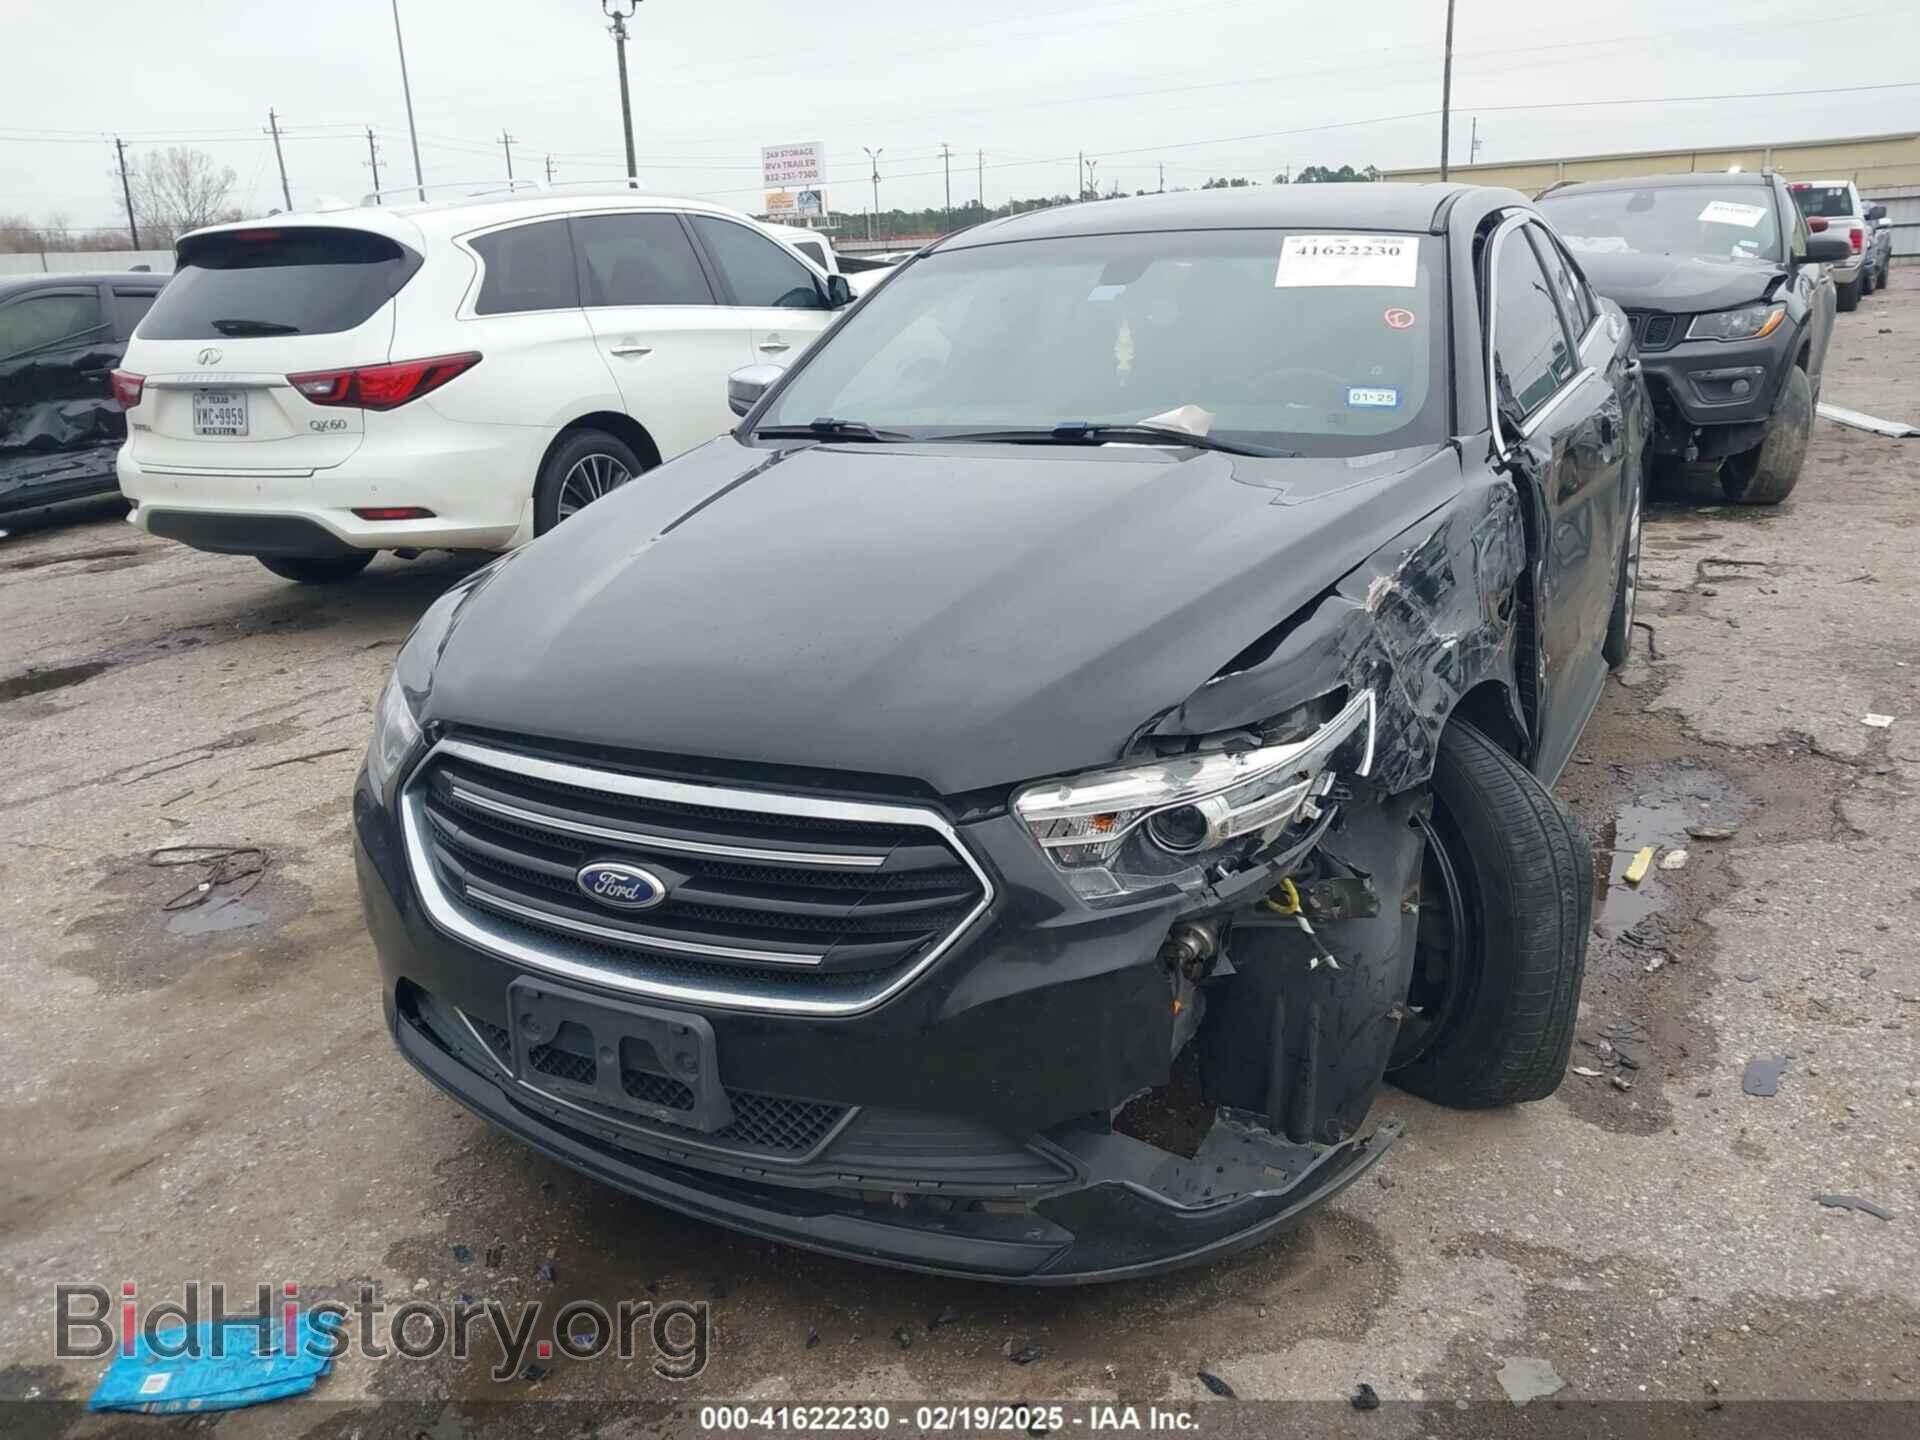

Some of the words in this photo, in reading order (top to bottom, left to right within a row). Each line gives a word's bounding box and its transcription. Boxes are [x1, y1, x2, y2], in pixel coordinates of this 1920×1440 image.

[781, 147, 814, 157] STORAGE
[783, 159, 816, 169] TRAILER
[1295, 245, 1401, 256] 41622230
[208, 396, 229, 404] TEXAS
[309, 420, 348, 432] QX60
[594, 871, 641, 900] Ford
